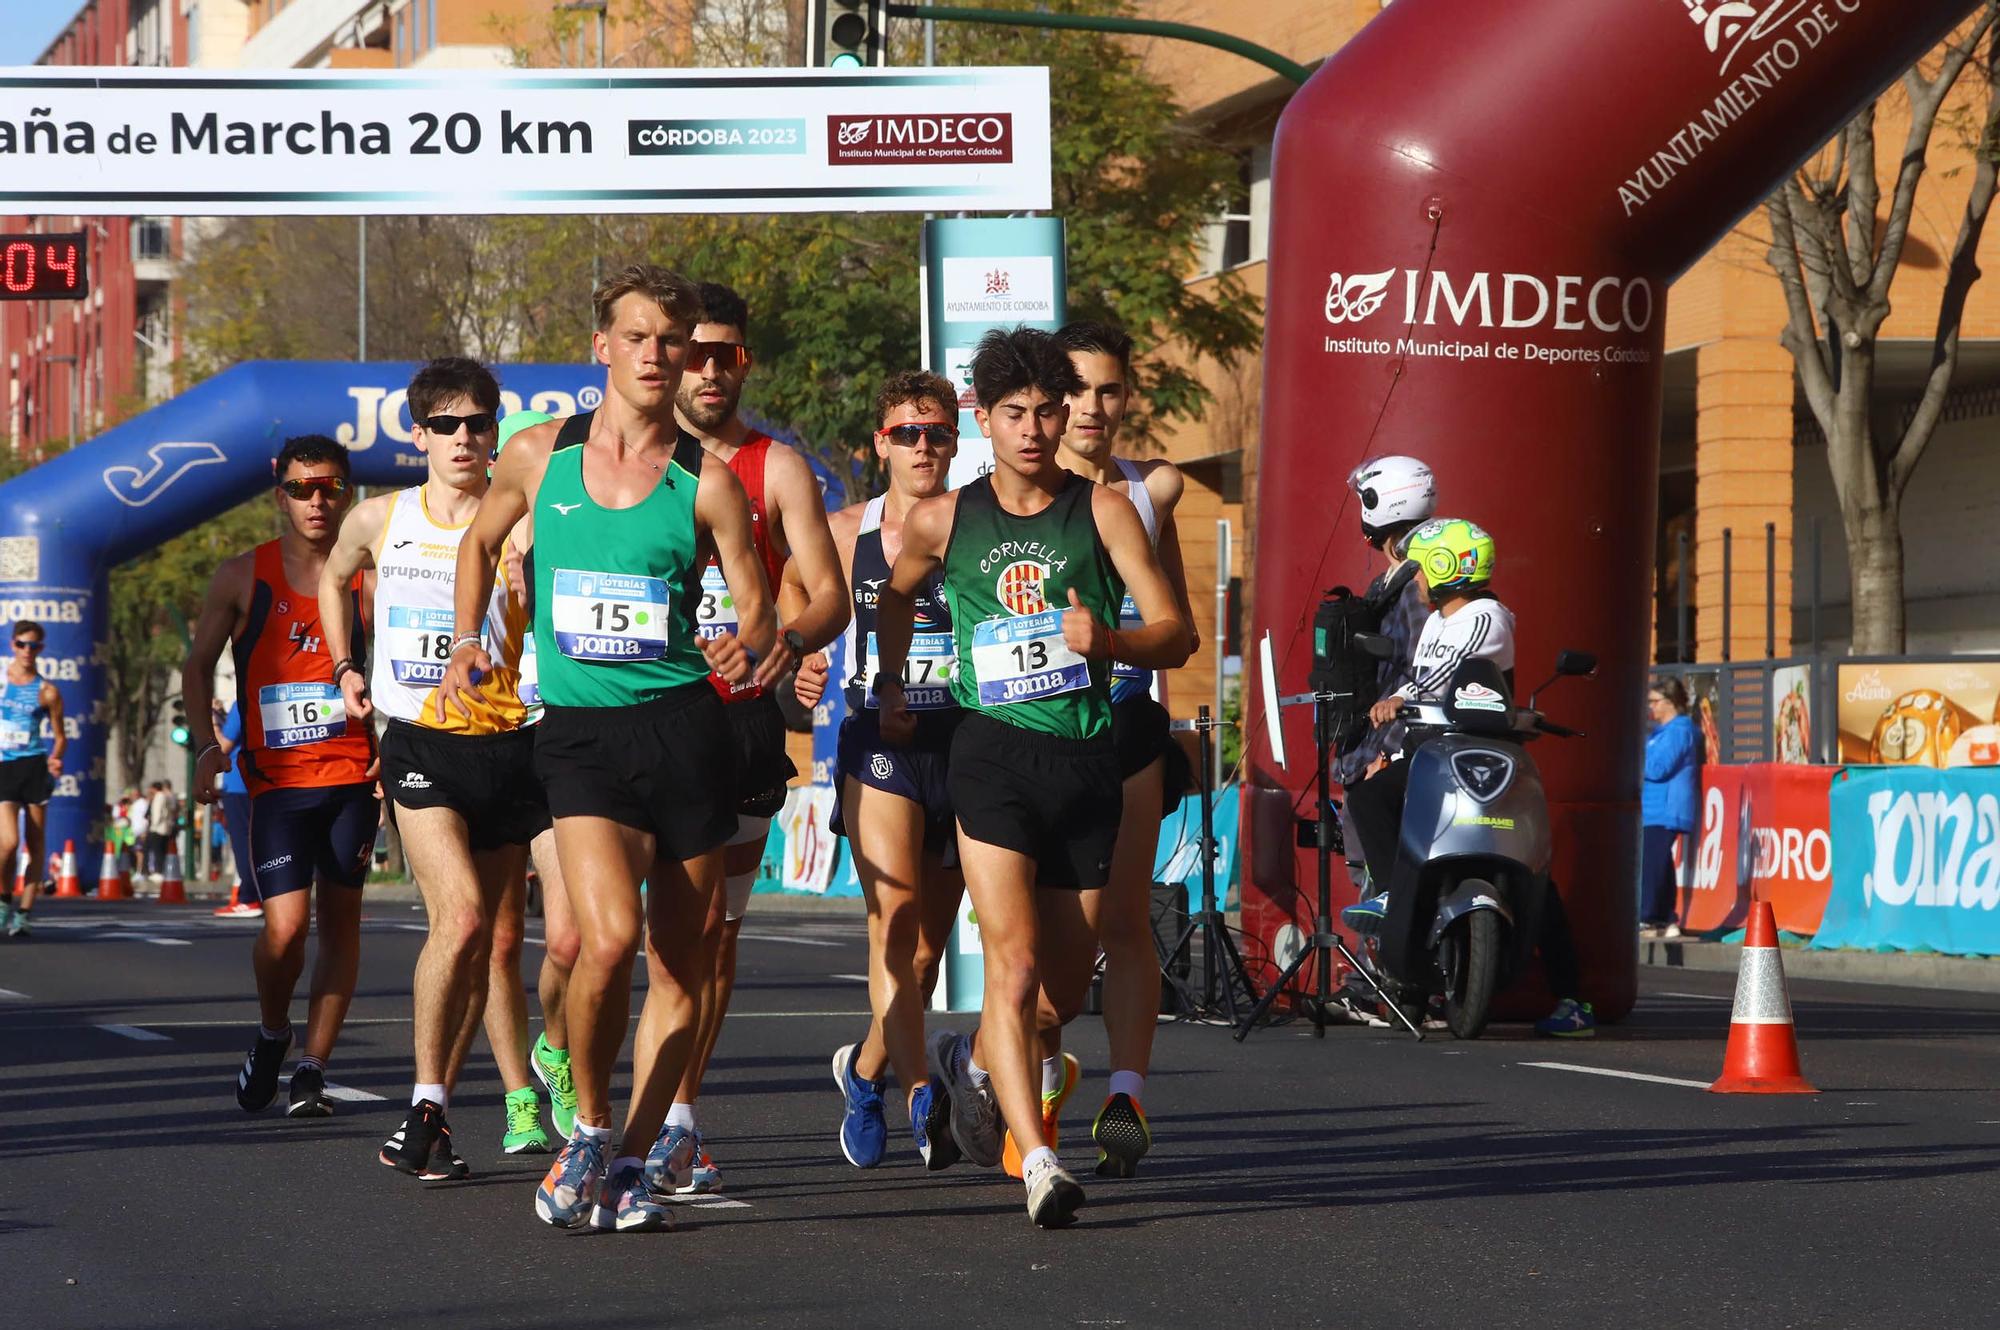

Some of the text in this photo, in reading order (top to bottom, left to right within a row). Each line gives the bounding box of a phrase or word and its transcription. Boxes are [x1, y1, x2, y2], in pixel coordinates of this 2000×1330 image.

[1617, 3, 1838, 217] AYUNTAMIENTO DE
[0, 107, 592, 155] aña de Marcha 20 km
[637, 125, 798, 146] CÓRDOBA 2023
[876, 117, 1004, 144] IMDECO
[839, 147, 1003, 159] Instituto Municipal de Deportes Córdoba
[946, 301, 1001, 313] AYUNTAMIENTO
[1003, 301, 1012, 312] DE
[1402, 269, 1652, 333] IMDECO
[1324, 336, 1391, 355] Instituto
[1396, 338, 1489, 361] Municipal
[1494, 342, 1519, 360] de
[1524, 343, 1600, 365] Deportes
[591, 602, 630, 632] 15
[1013, 616, 1055, 629] LOTERÍAS
[417, 633, 452, 660] 18
[572, 635, 641, 655] Joma
[1011, 641, 1048, 673] 13
[400, 662, 447, 680] Jom
[904, 659, 933, 684] 17
[1003, 671, 1067, 699] Joma
[288, 702, 318, 724] 16
[280, 726, 330, 745] Joma
